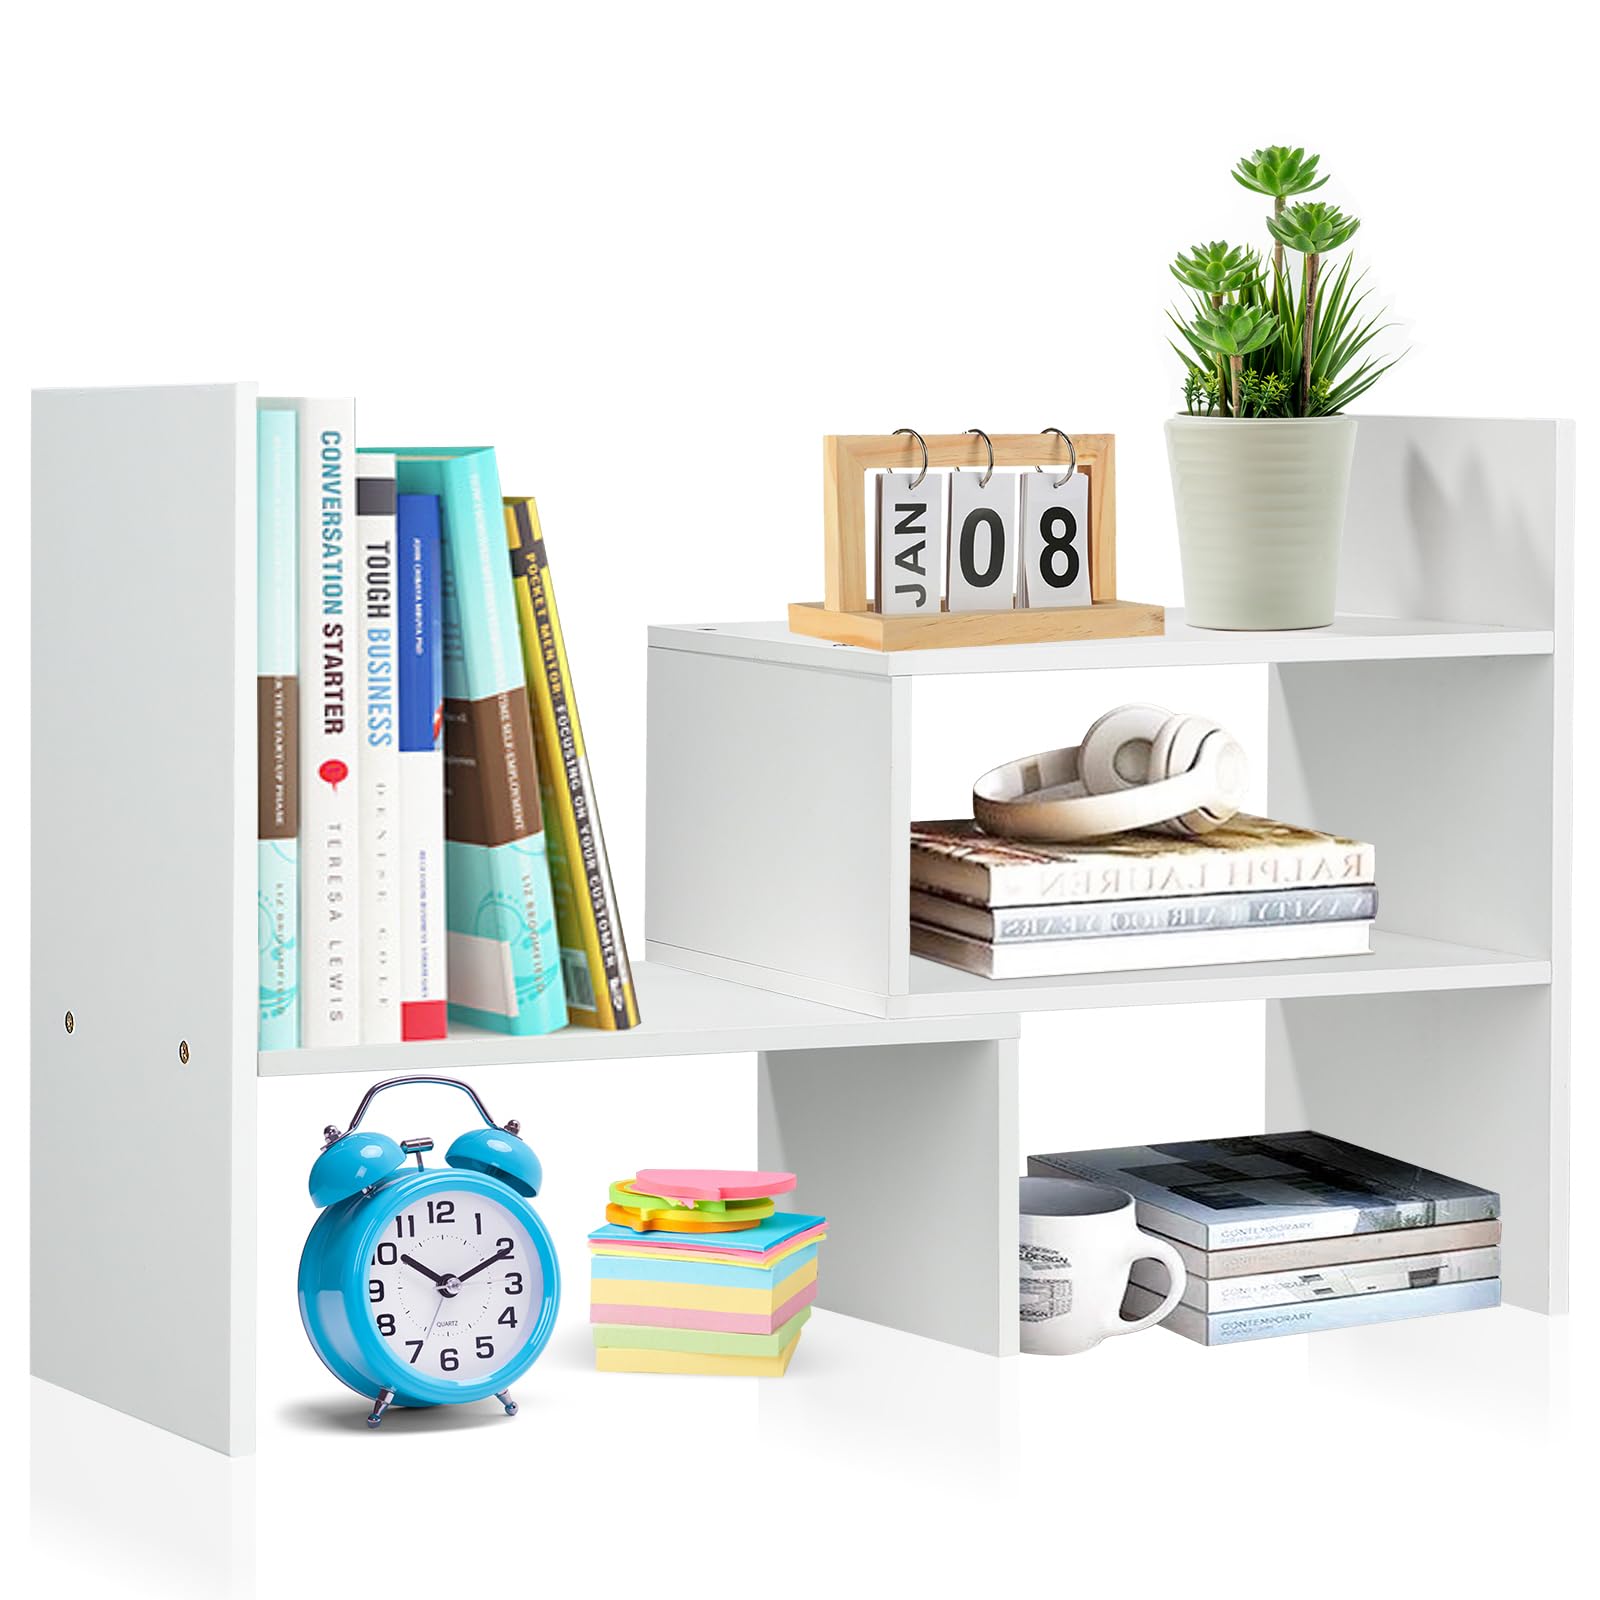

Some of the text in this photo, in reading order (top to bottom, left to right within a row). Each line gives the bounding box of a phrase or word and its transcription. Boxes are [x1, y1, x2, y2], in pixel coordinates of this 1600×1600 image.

[894, 503, 928, 608] JAN
[959, 506, 1081, 589] 0 8
[321, 431, 344, 735] CONVERSATION STARTER
[525, 552, 548, 617] POCKET
[366, 540, 392, 748] TOUGH BUSINESS
[556, 703, 580, 791] FOCUSING
[275, 784, 285, 826] PHASE
[573, 795, 588, 820] ON
[580, 823, 596, 870] YOUR
[521, 874, 533, 896] LIZ
[327, 823, 343, 1022] TERESA LEWIS
[589, 874, 616, 969] CUSTOMER
[427, 1200, 455, 1224] 12
[474, 1212, 482, 1235] 1
[396, 1214, 415, 1238] 11
[1221, 1223, 1312, 1238] CONTEMPORARY
[495, 1237, 515, 1260] 2
[369, 1279, 385, 1303] 9
[504, 1272, 523, 1295] 3
[376, 1313, 396, 1337] 8
[436, 1320, 459, 1328] QUARTZ
[497, 1306, 518, 1329] 4
[1221, 1312, 1312, 1331] CONTEMPORARY
[405, 1339, 424, 1364] 7
[475, 1335, 495, 1360] 5
[440, 1348, 460, 1372] 6
